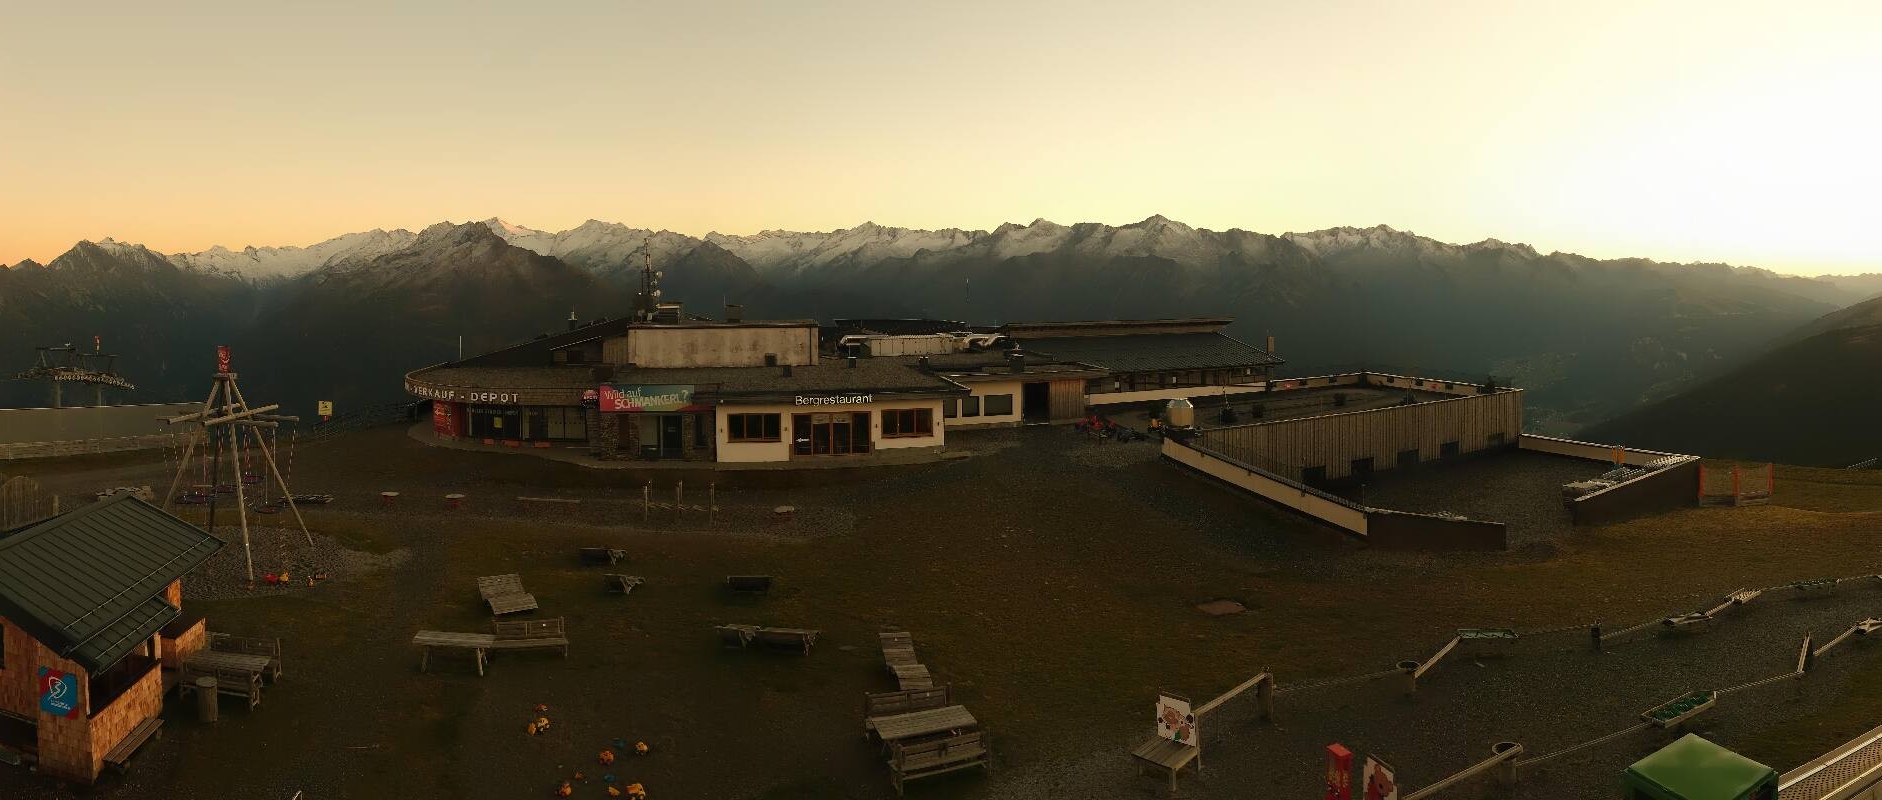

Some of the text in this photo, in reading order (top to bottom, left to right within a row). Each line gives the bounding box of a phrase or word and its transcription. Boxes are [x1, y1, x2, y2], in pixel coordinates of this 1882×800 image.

[414, 386, 455, 399] VERKAUF
[470, 392, 519, 403] DEPOT
[604, 389, 625, 400] Wild
[626, 387, 642, 398] auf
[614, 389, 689, 410] SCHMANKERL?
[795, 394, 873, 406] Bergrestaurant
